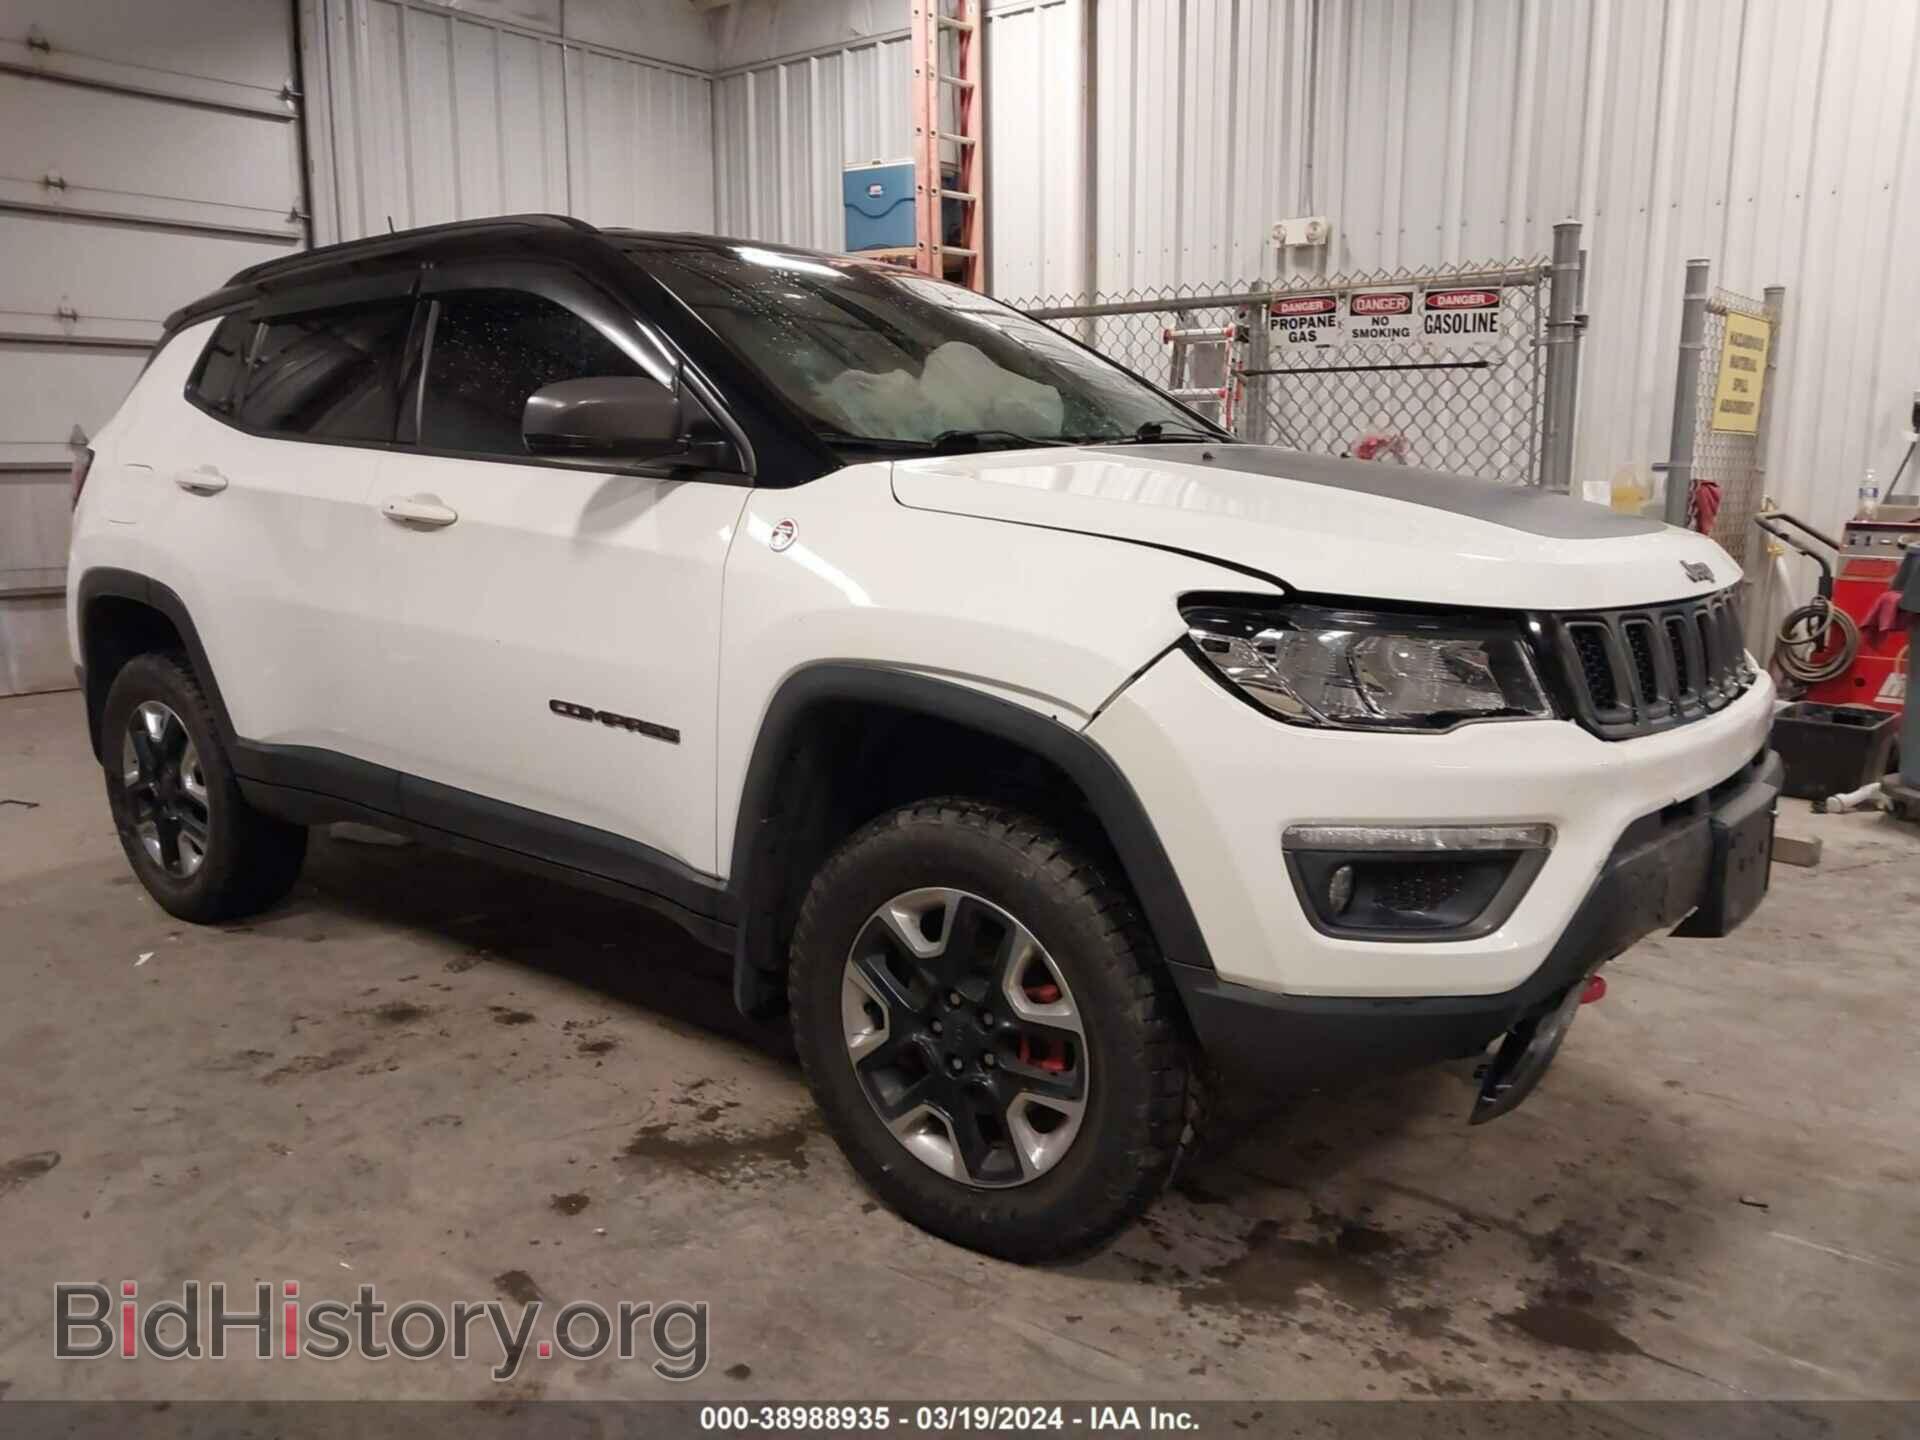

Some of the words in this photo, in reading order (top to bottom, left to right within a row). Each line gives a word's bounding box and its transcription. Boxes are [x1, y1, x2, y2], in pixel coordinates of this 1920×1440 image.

[1356, 295, 1407, 312] DANGER
[1437, 294, 1486, 307] DANGER
[1280, 302, 1323, 313] DANGER
[1270, 315, 1337, 331] PROPANE
[1371, 316, 1390, 327] NO
[1424, 312, 1499, 335] GASOLINE
[1288, 330, 1318, 343] GAS
[1351, 327, 1411, 339] SMOKING
